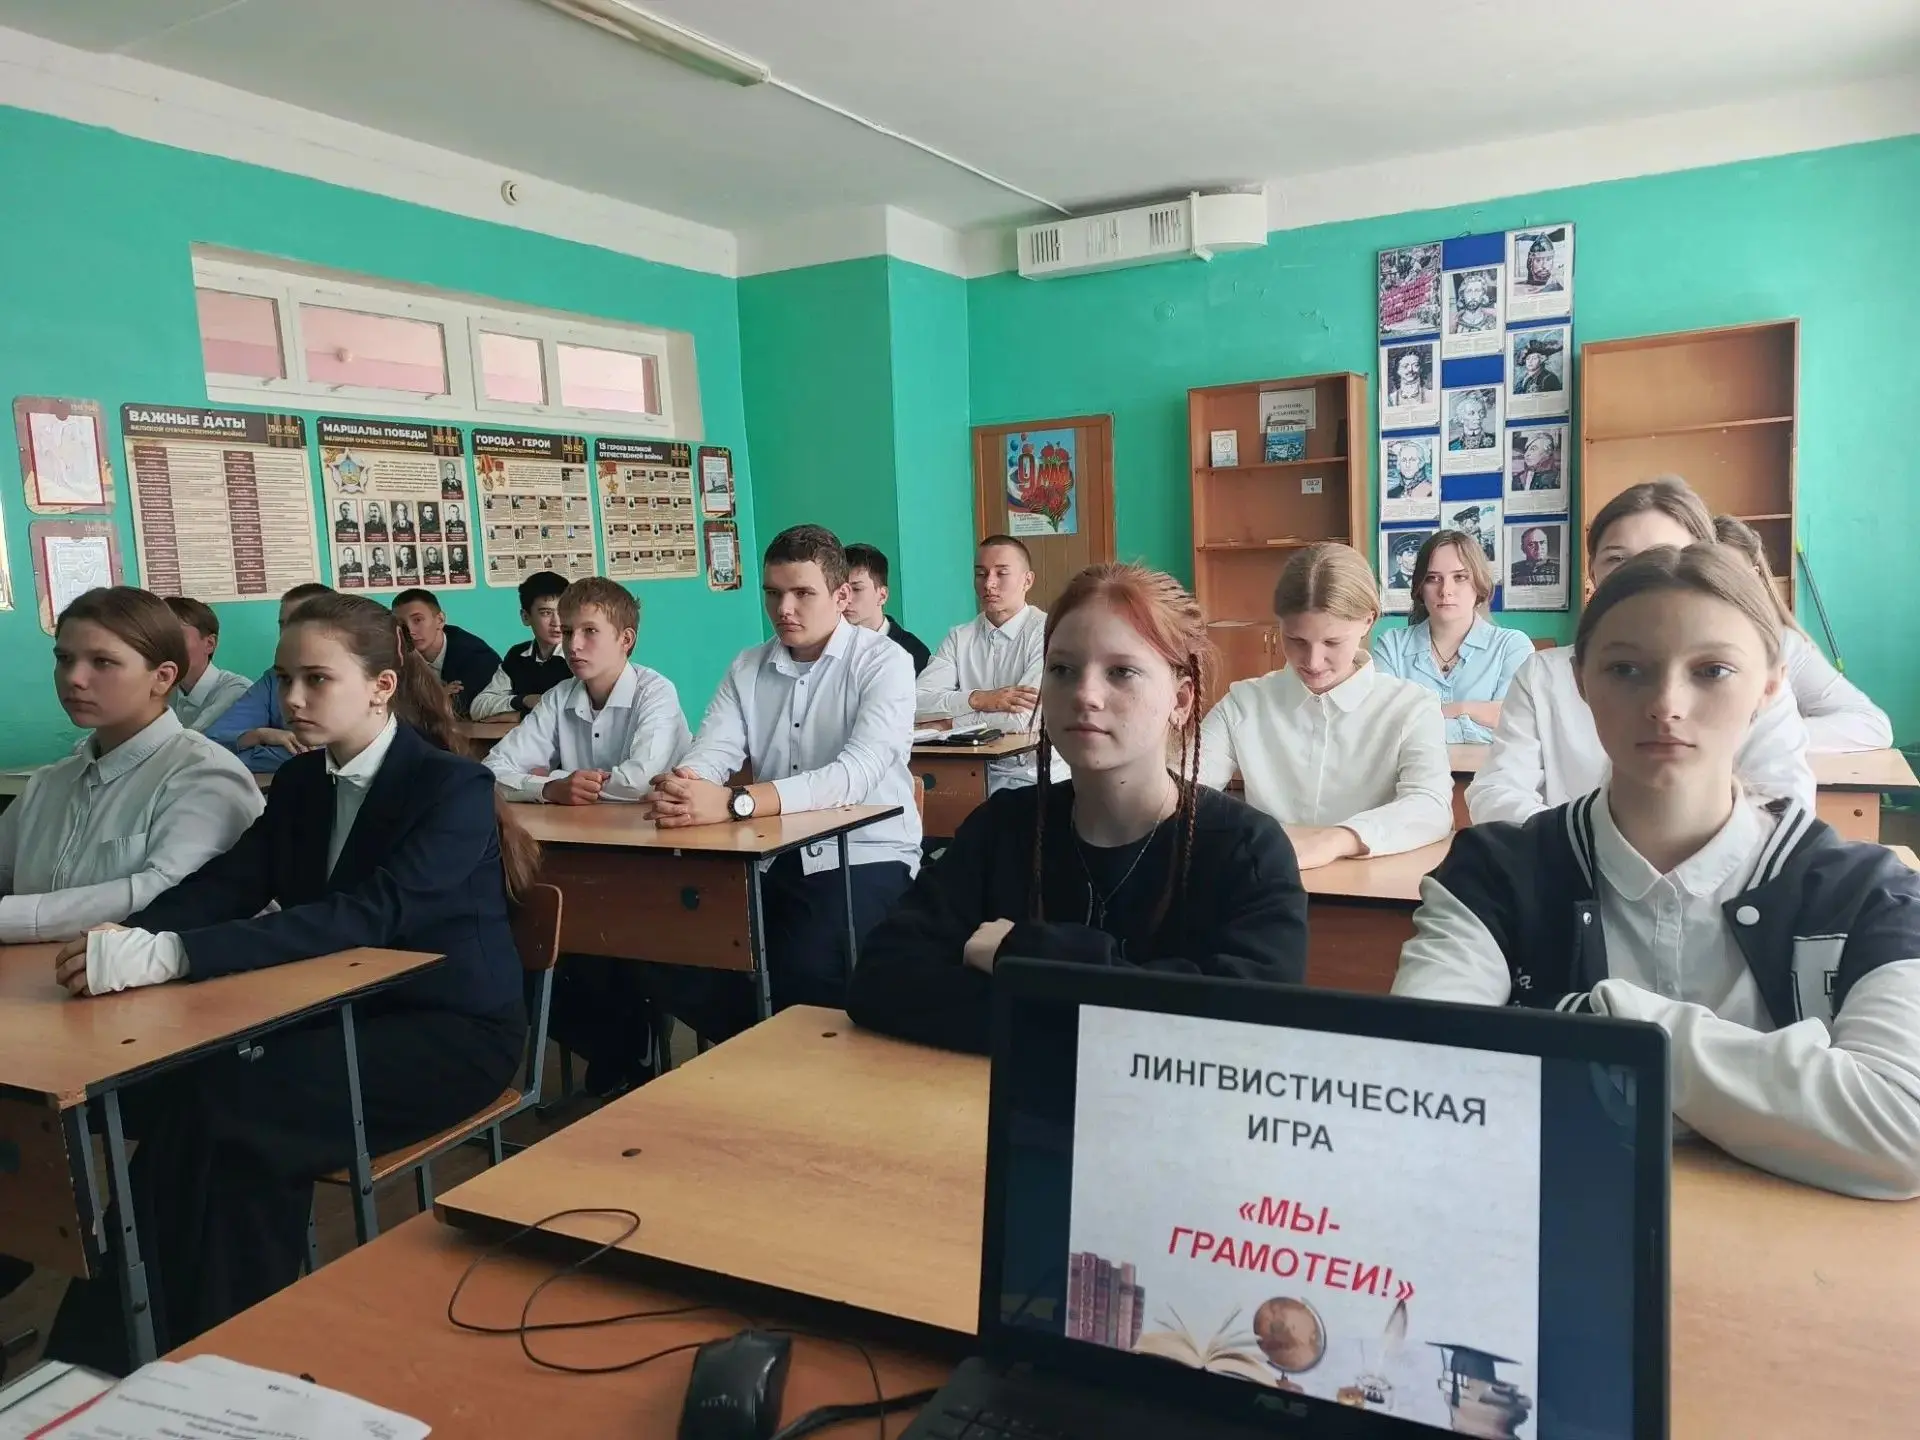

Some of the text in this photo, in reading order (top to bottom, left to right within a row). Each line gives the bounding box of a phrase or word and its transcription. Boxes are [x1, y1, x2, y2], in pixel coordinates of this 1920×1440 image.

[128, 410, 247, 429] ВАЖНЫЕ ДАТЫ
[130, 424, 247, 438] ВЕЛИКОЙ ОТЕЧЕСТВЕННОЙ ВОЙНЫ
[322, 423, 428, 440] МАРШАЛЫ ПОБЕДЫ
[355, 436, 406, 446] ОТЕЧЕСТВЕННОЙ
[406, 440, 428, 448] ВОЙНЫ
[475, 434, 515, 446] ГОРОДА
[522, 438, 551, 449] ГЕРОИ
[599, 452, 644, 460] ОТЕЧЕСТВЕННОЙ
[1017, 453, 1037, 494] 9
[1128, 1052, 1488, 1126] ЛИНГВИСТИЧЕСКАЯ
[1247, 1114, 1334, 1153] ИГРА
[1237, 1196, 1342, 1237] «МЫ-
[1167, 1226, 1416, 1302] ГРАМОТЕИ!»
